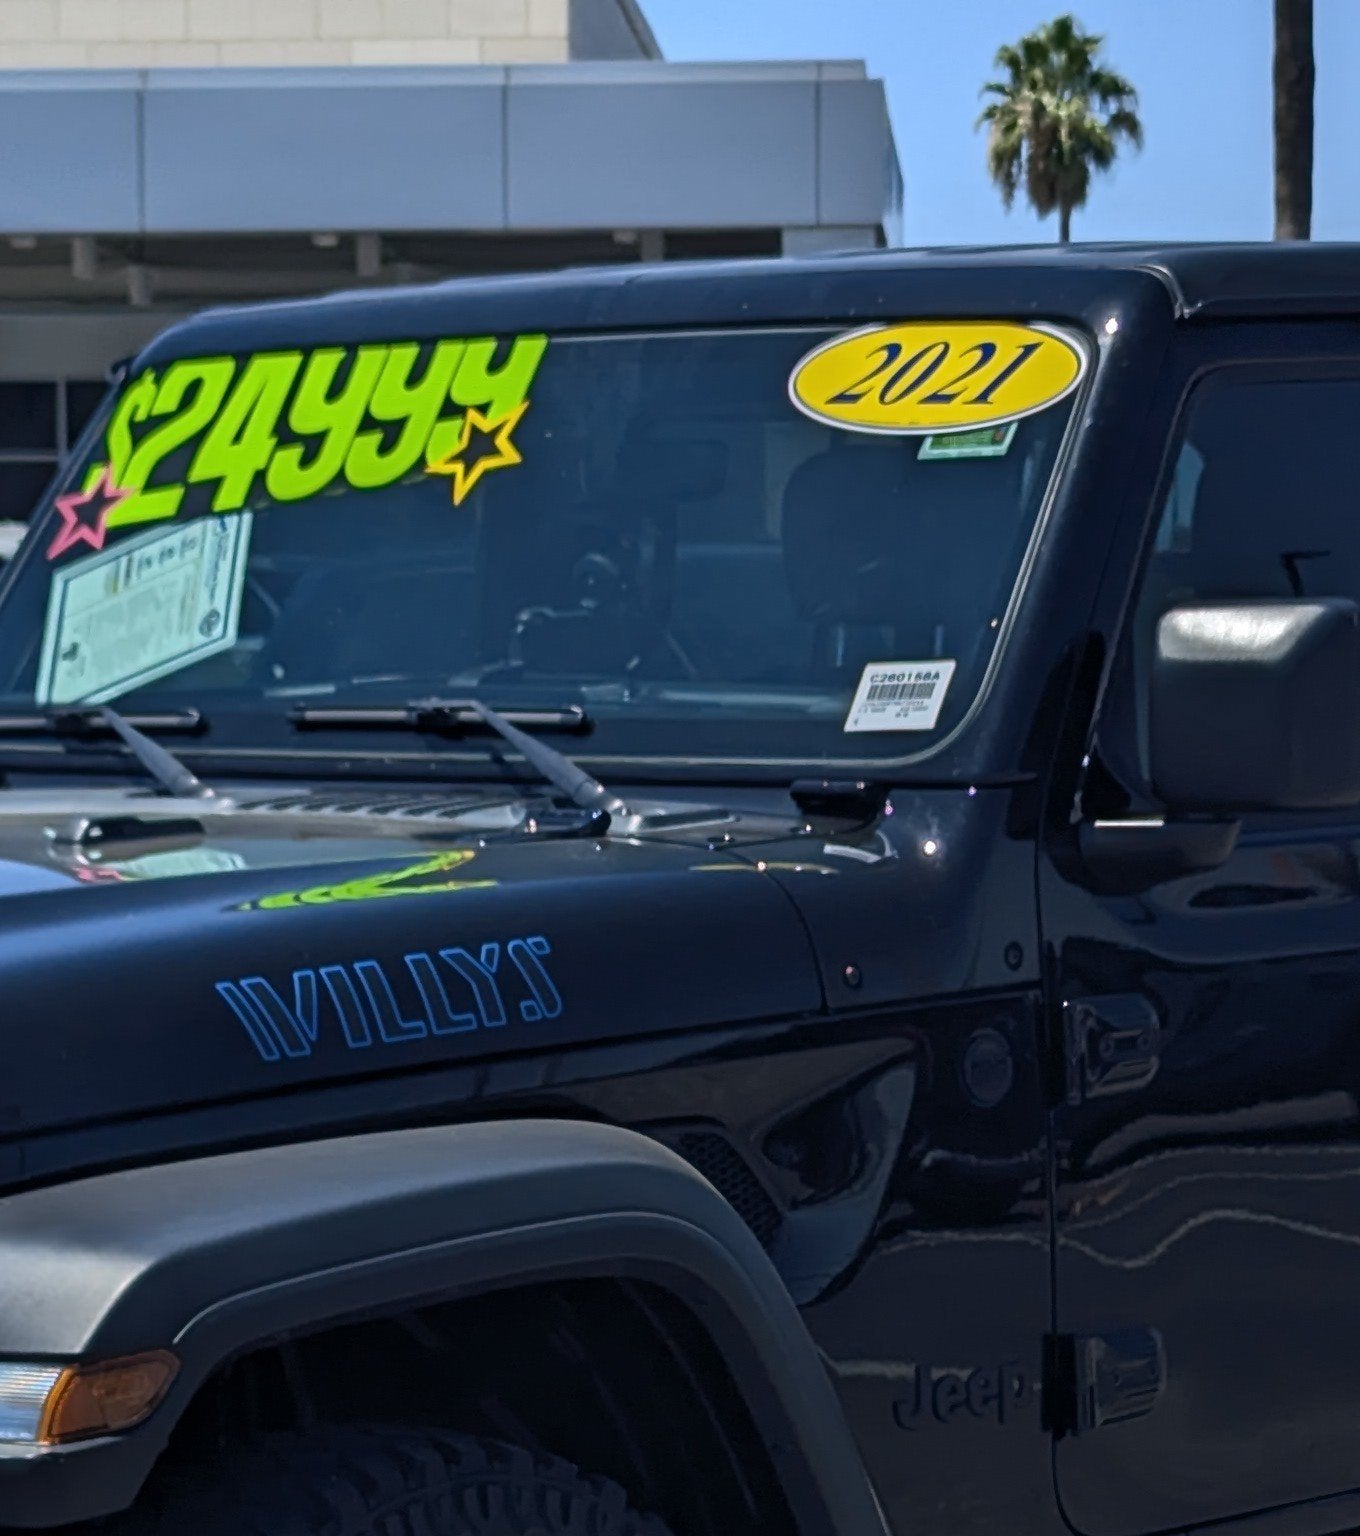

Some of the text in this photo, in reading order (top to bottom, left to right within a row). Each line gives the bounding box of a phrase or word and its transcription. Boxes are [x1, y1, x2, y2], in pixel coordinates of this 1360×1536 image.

[824, 341, 1045, 406] 2021
[82, 334, 548, 529] $24999
[214, 934, 564, 1063] WILLYS
[892, 1360, 1026, 1432] Jeep
